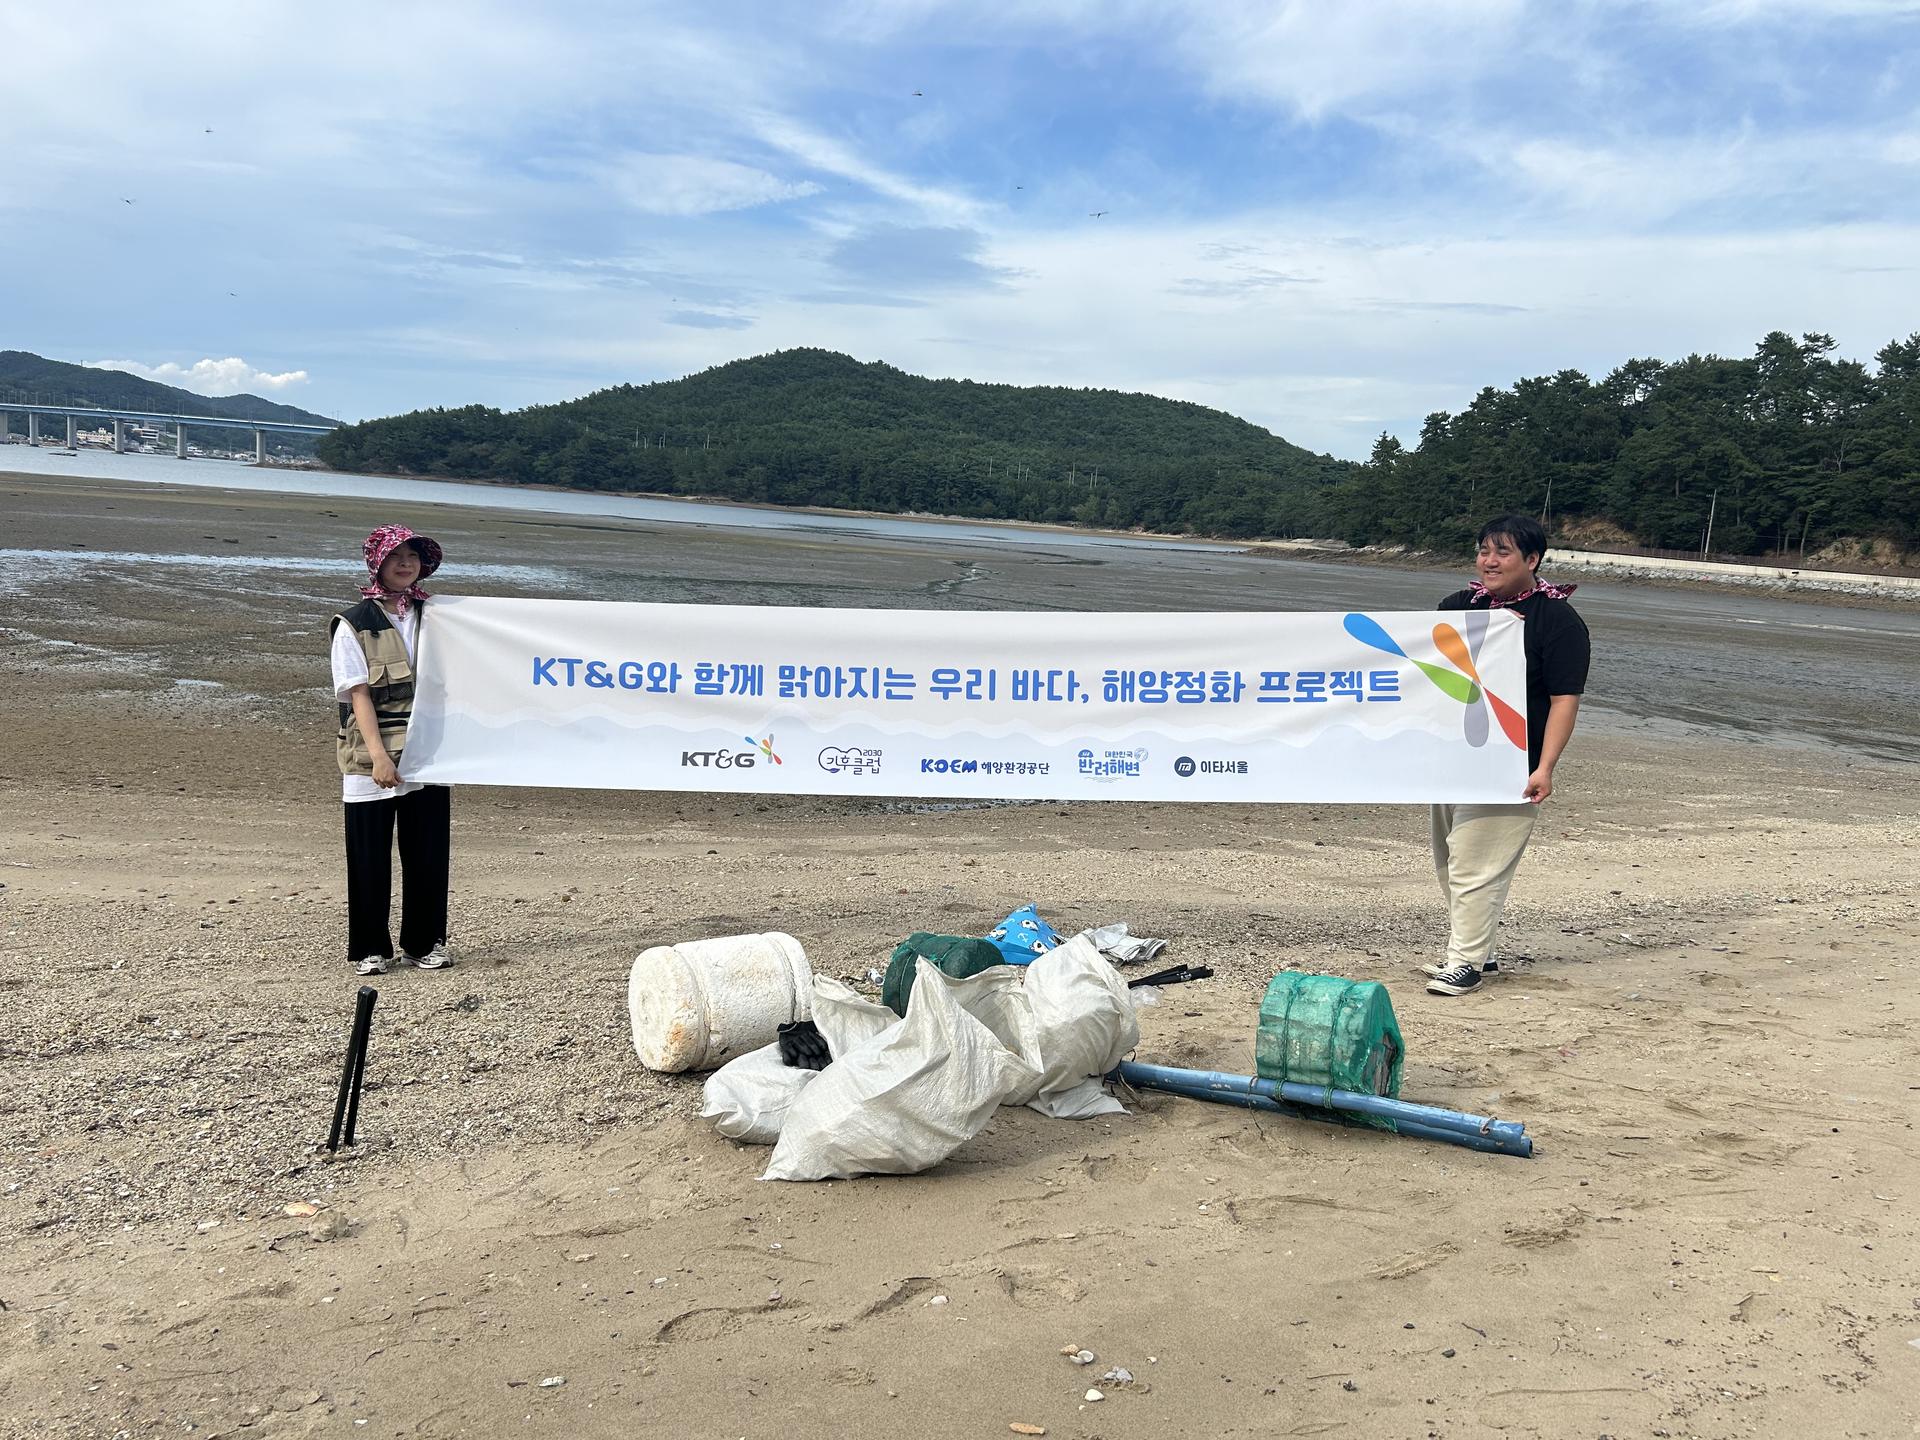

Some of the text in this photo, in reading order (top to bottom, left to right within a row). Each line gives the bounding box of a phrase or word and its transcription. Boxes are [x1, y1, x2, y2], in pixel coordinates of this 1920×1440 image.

[532, 657, 1402, 704] KT&G와 함께 맑아지는 우리 바다, 해양정화 프로젝트
[681, 750, 756, 770] KT&G
[862, 749, 883, 757] 2030
[1104, 750, 1134, 759] 대한민국
[825, 755, 882, 775] 기후클럽
[920, 758, 978, 774] KOEM
[980, 761, 1051, 775] 해양환경공단
[1078, 758, 1140, 777] 반려해변
[1200, 760, 1249, 774] 이타서울
